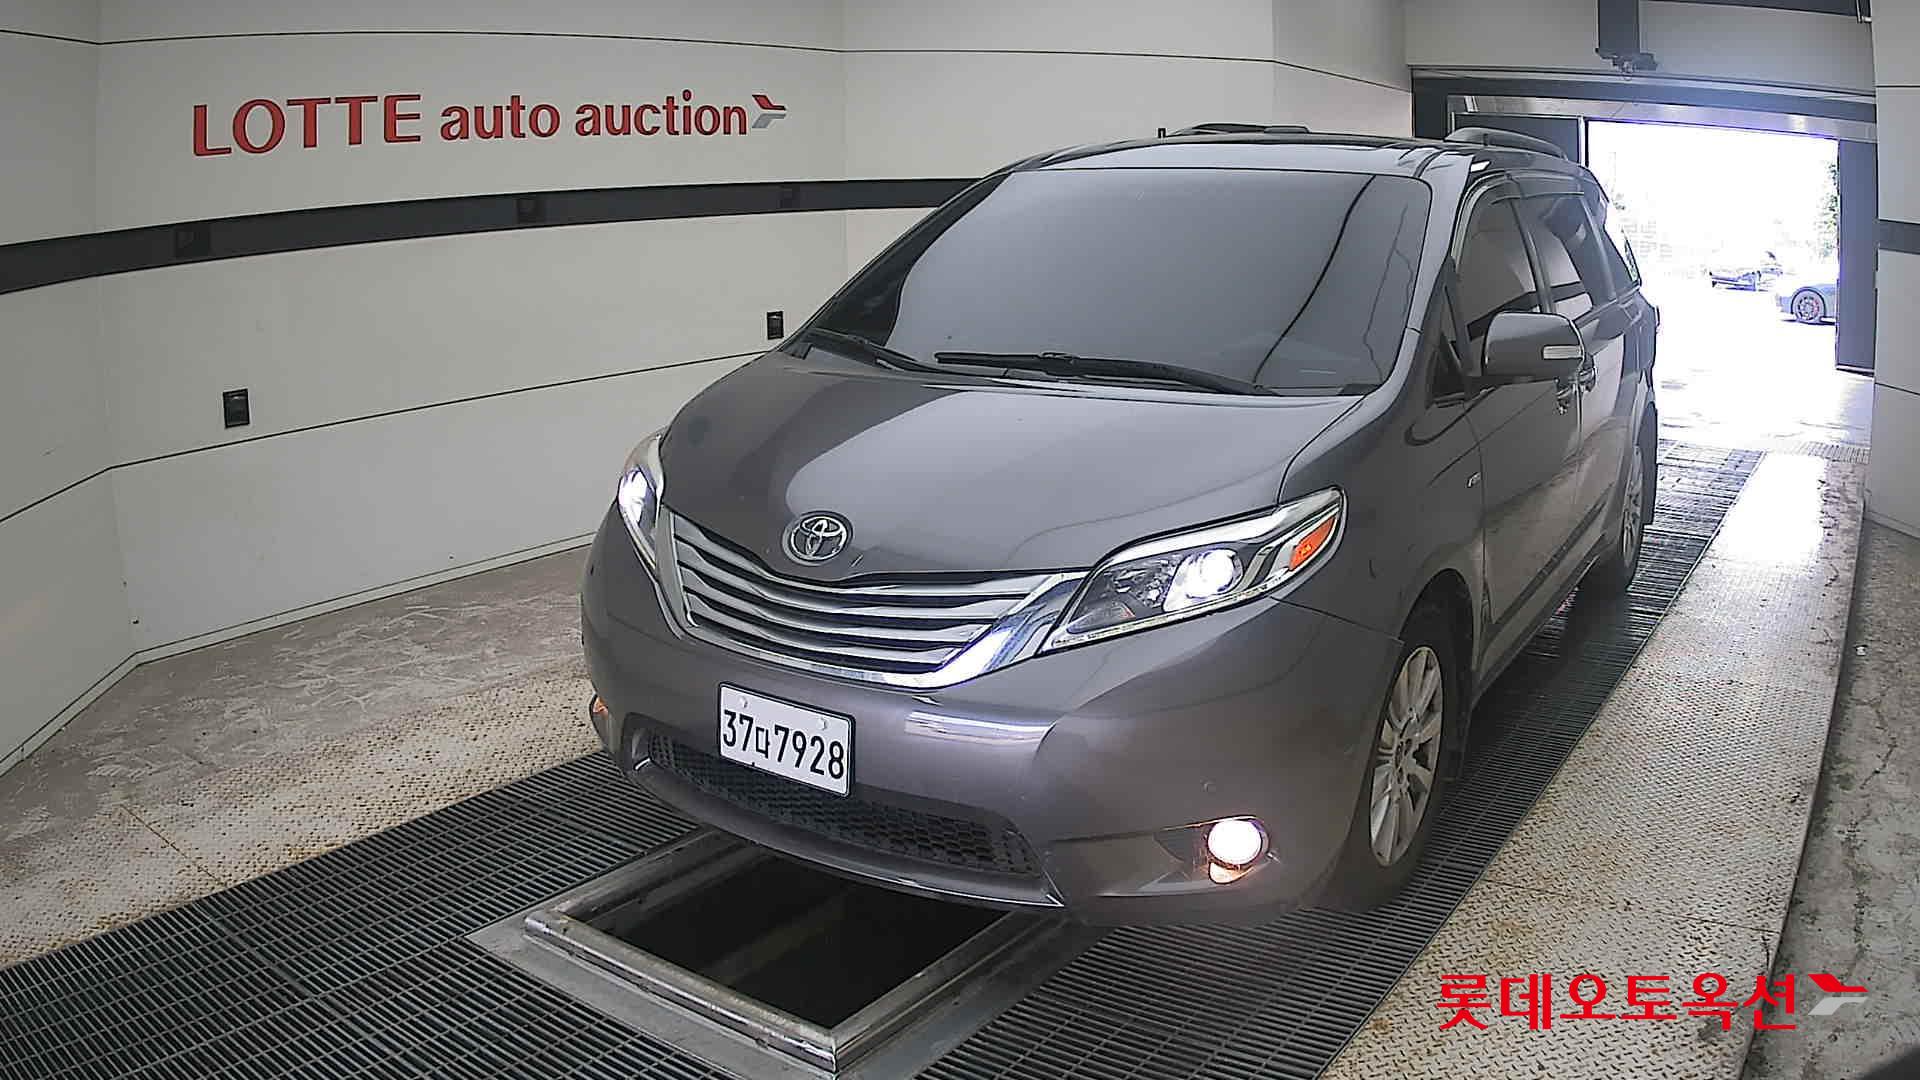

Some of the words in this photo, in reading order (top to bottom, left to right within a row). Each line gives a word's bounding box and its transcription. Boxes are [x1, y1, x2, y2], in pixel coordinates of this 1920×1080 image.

[192, 94, 422, 156] LOTTE
[440, 95, 560, 140] auto
[575, 89, 749, 136] auction
